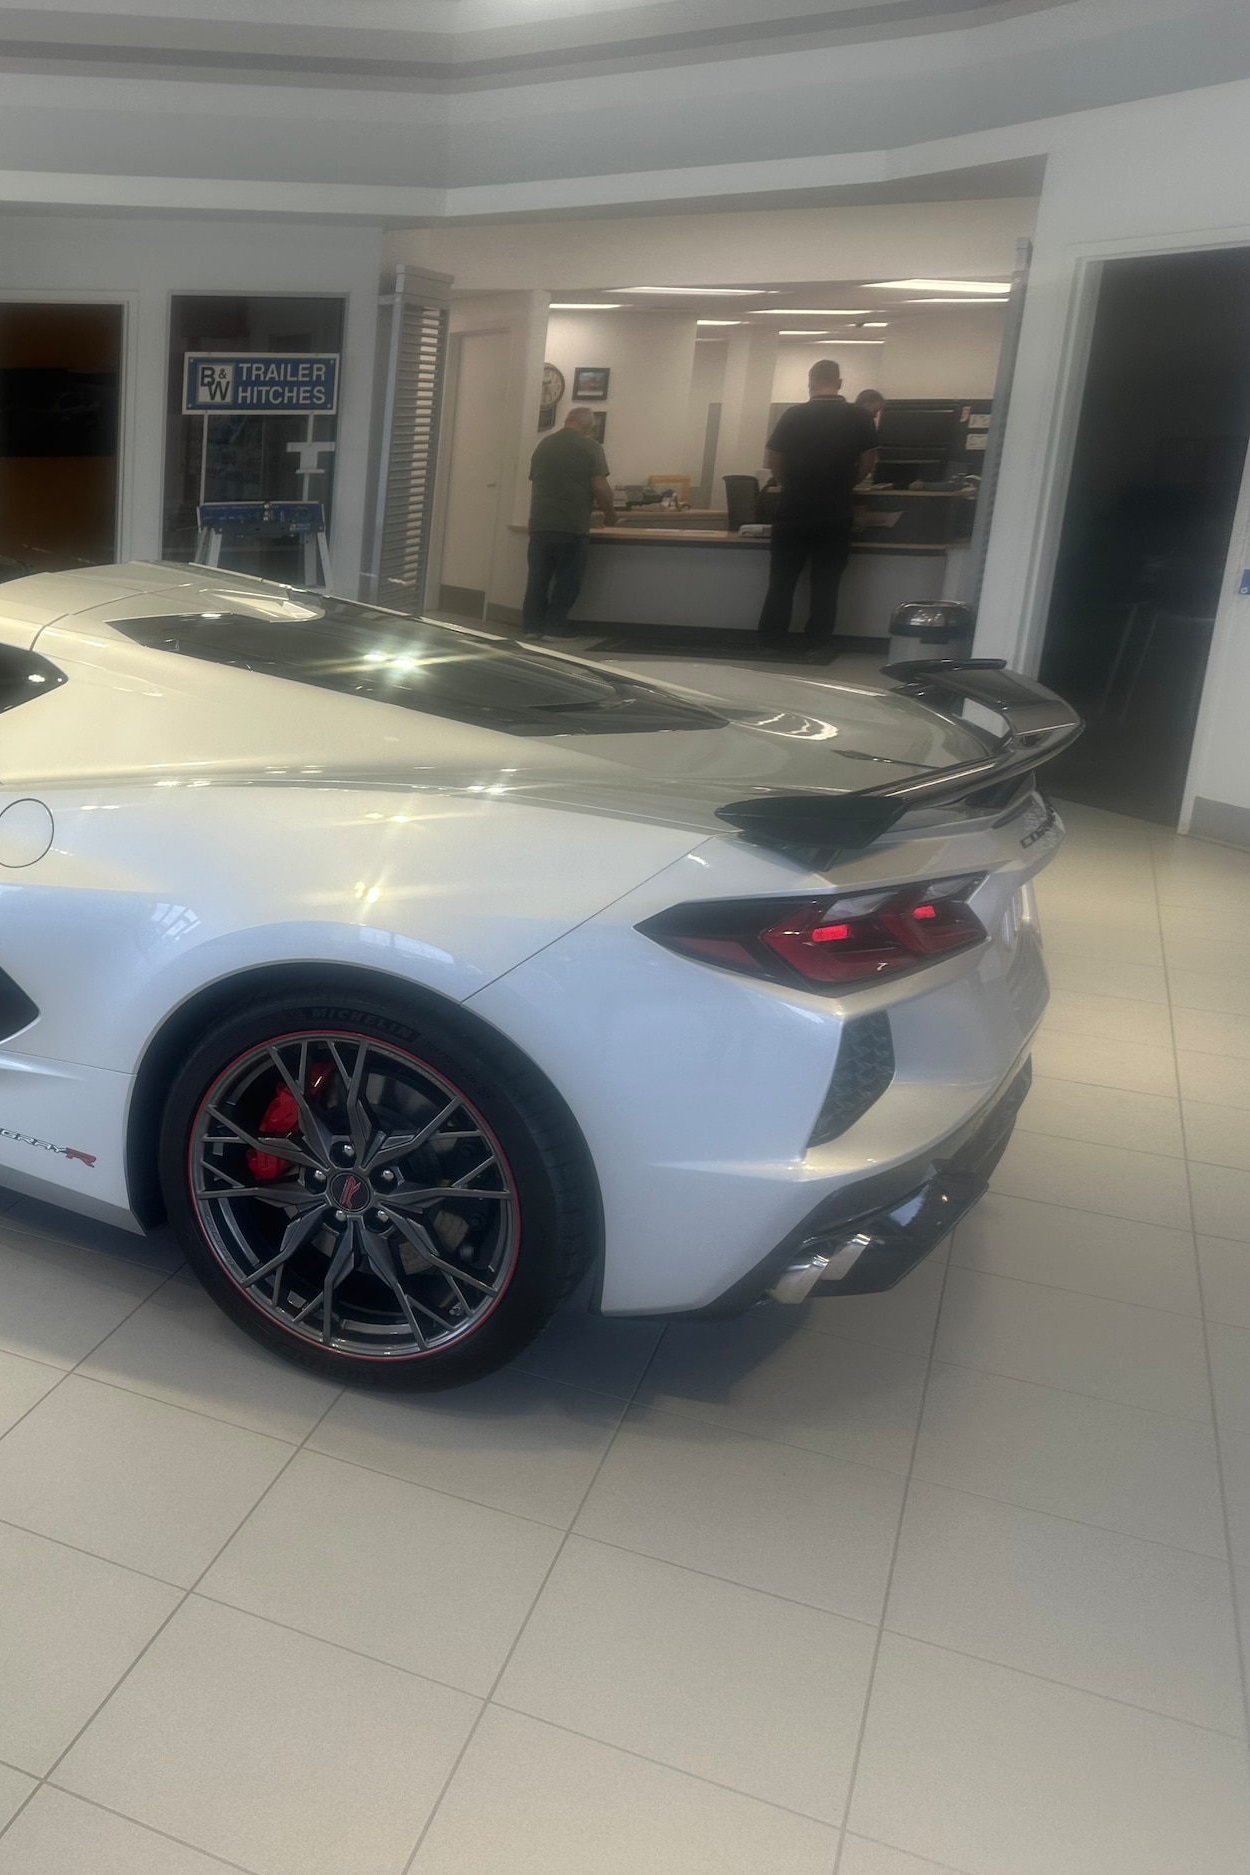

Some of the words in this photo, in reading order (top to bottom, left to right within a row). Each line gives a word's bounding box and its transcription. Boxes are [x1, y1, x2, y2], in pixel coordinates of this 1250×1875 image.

[238, 363, 326, 382] TRAILER
[237, 386, 326, 405] HITCHES
[310, 1006, 414, 1040] MICHELIN
